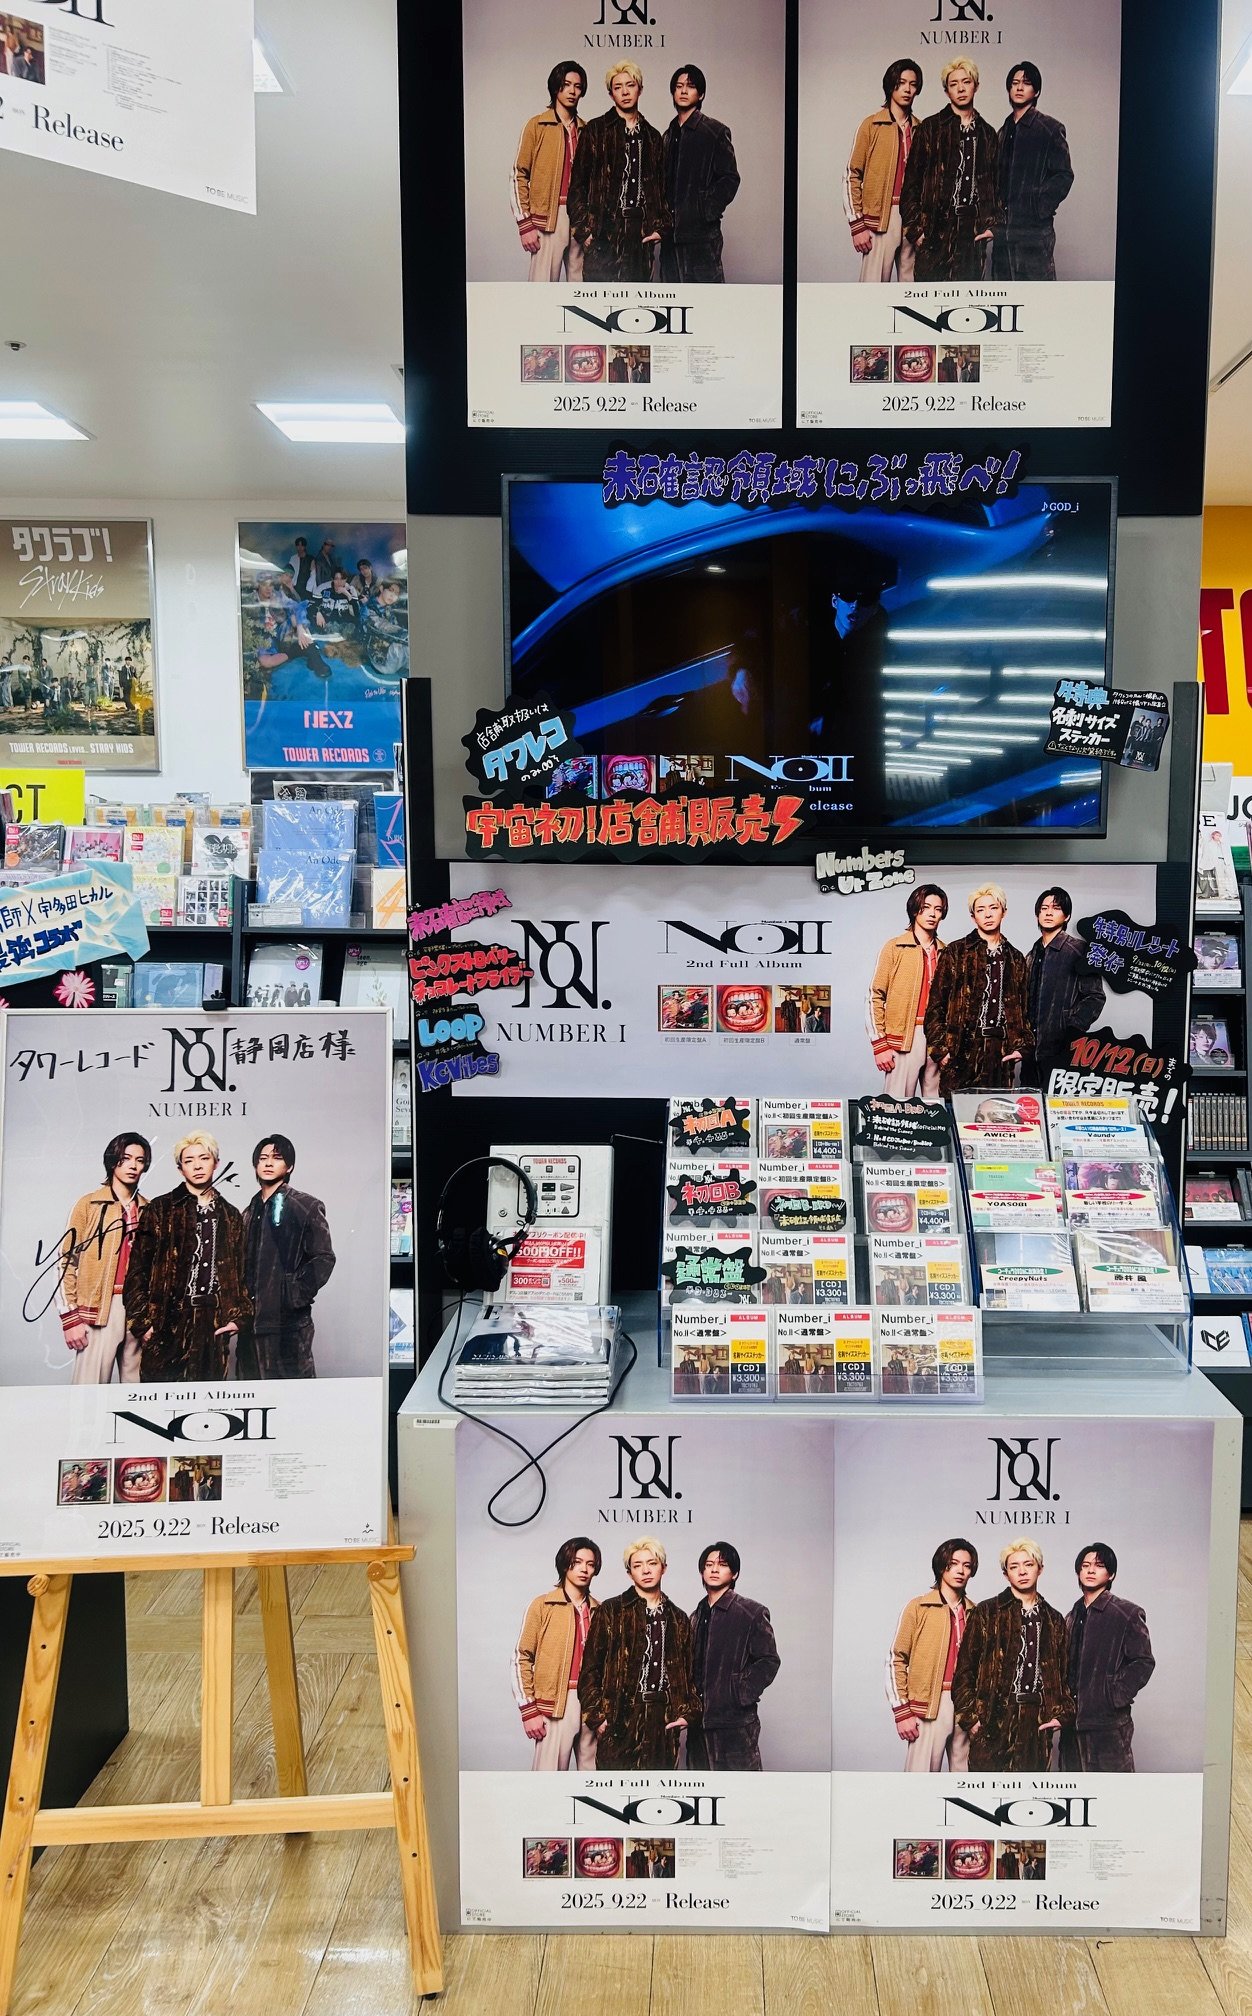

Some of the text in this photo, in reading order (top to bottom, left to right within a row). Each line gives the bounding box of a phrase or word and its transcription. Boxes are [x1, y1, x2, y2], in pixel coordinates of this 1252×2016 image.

[32, 103, 125, 152] Release
[573, 290, 598, 298] 2nd
[635, 290, 676, 298] Album
[904, 290, 1008, 298] 2nd Full Album
[642, 396, 698, 412] Release
[970, 396, 1026, 412] Release
[12, 526, 113, 563] タクラブ!
[1058, 728, 1110, 746] ステッカー
[9, 742, 134, 754] TOWER RECORDS STRAY KIDS
[482, 715, 568, 782] タワレコ
[282, 747, 370, 764] TOWER RECORDS
[809, 800, 854, 811] elease
[816, 846, 905, 880] Numbers
[686, 960, 802, 968] 2nd Full Album
[418, 1013, 483, 1048] LOOP
[10, 1042, 156, 1082] タワーレコード
[764, 1101, 808, 1110] Number_i
[670, 1162, 715, 1172] Number_i
[760, 1163, 805, 1172] Number_i
[866, 1166, 912, 1176] Number_i
[666, 1232, 714, 1242] Number_i
[761, 1236, 810, 1246] Number_i
[874, 1238, 922, 1249] Number_i
[675, 1254, 746, 1284] 通常盤
[674, 1314, 727, 1325] Number_i
[778, 1314, 831, 1324] Number_i
[881, 1314, 934, 1325] Number_i
[128, 1390, 256, 1402] 2nd Full Album
[210, 1516, 280, 1536] Release
[585, 1779, 706, 1788] 2nd Full Album
[956, 1781, 1078, 1790] 2nd Full Album
[665, 1892, 730, 1910] Release
[1036, 1894, 1100, 1912] Release
